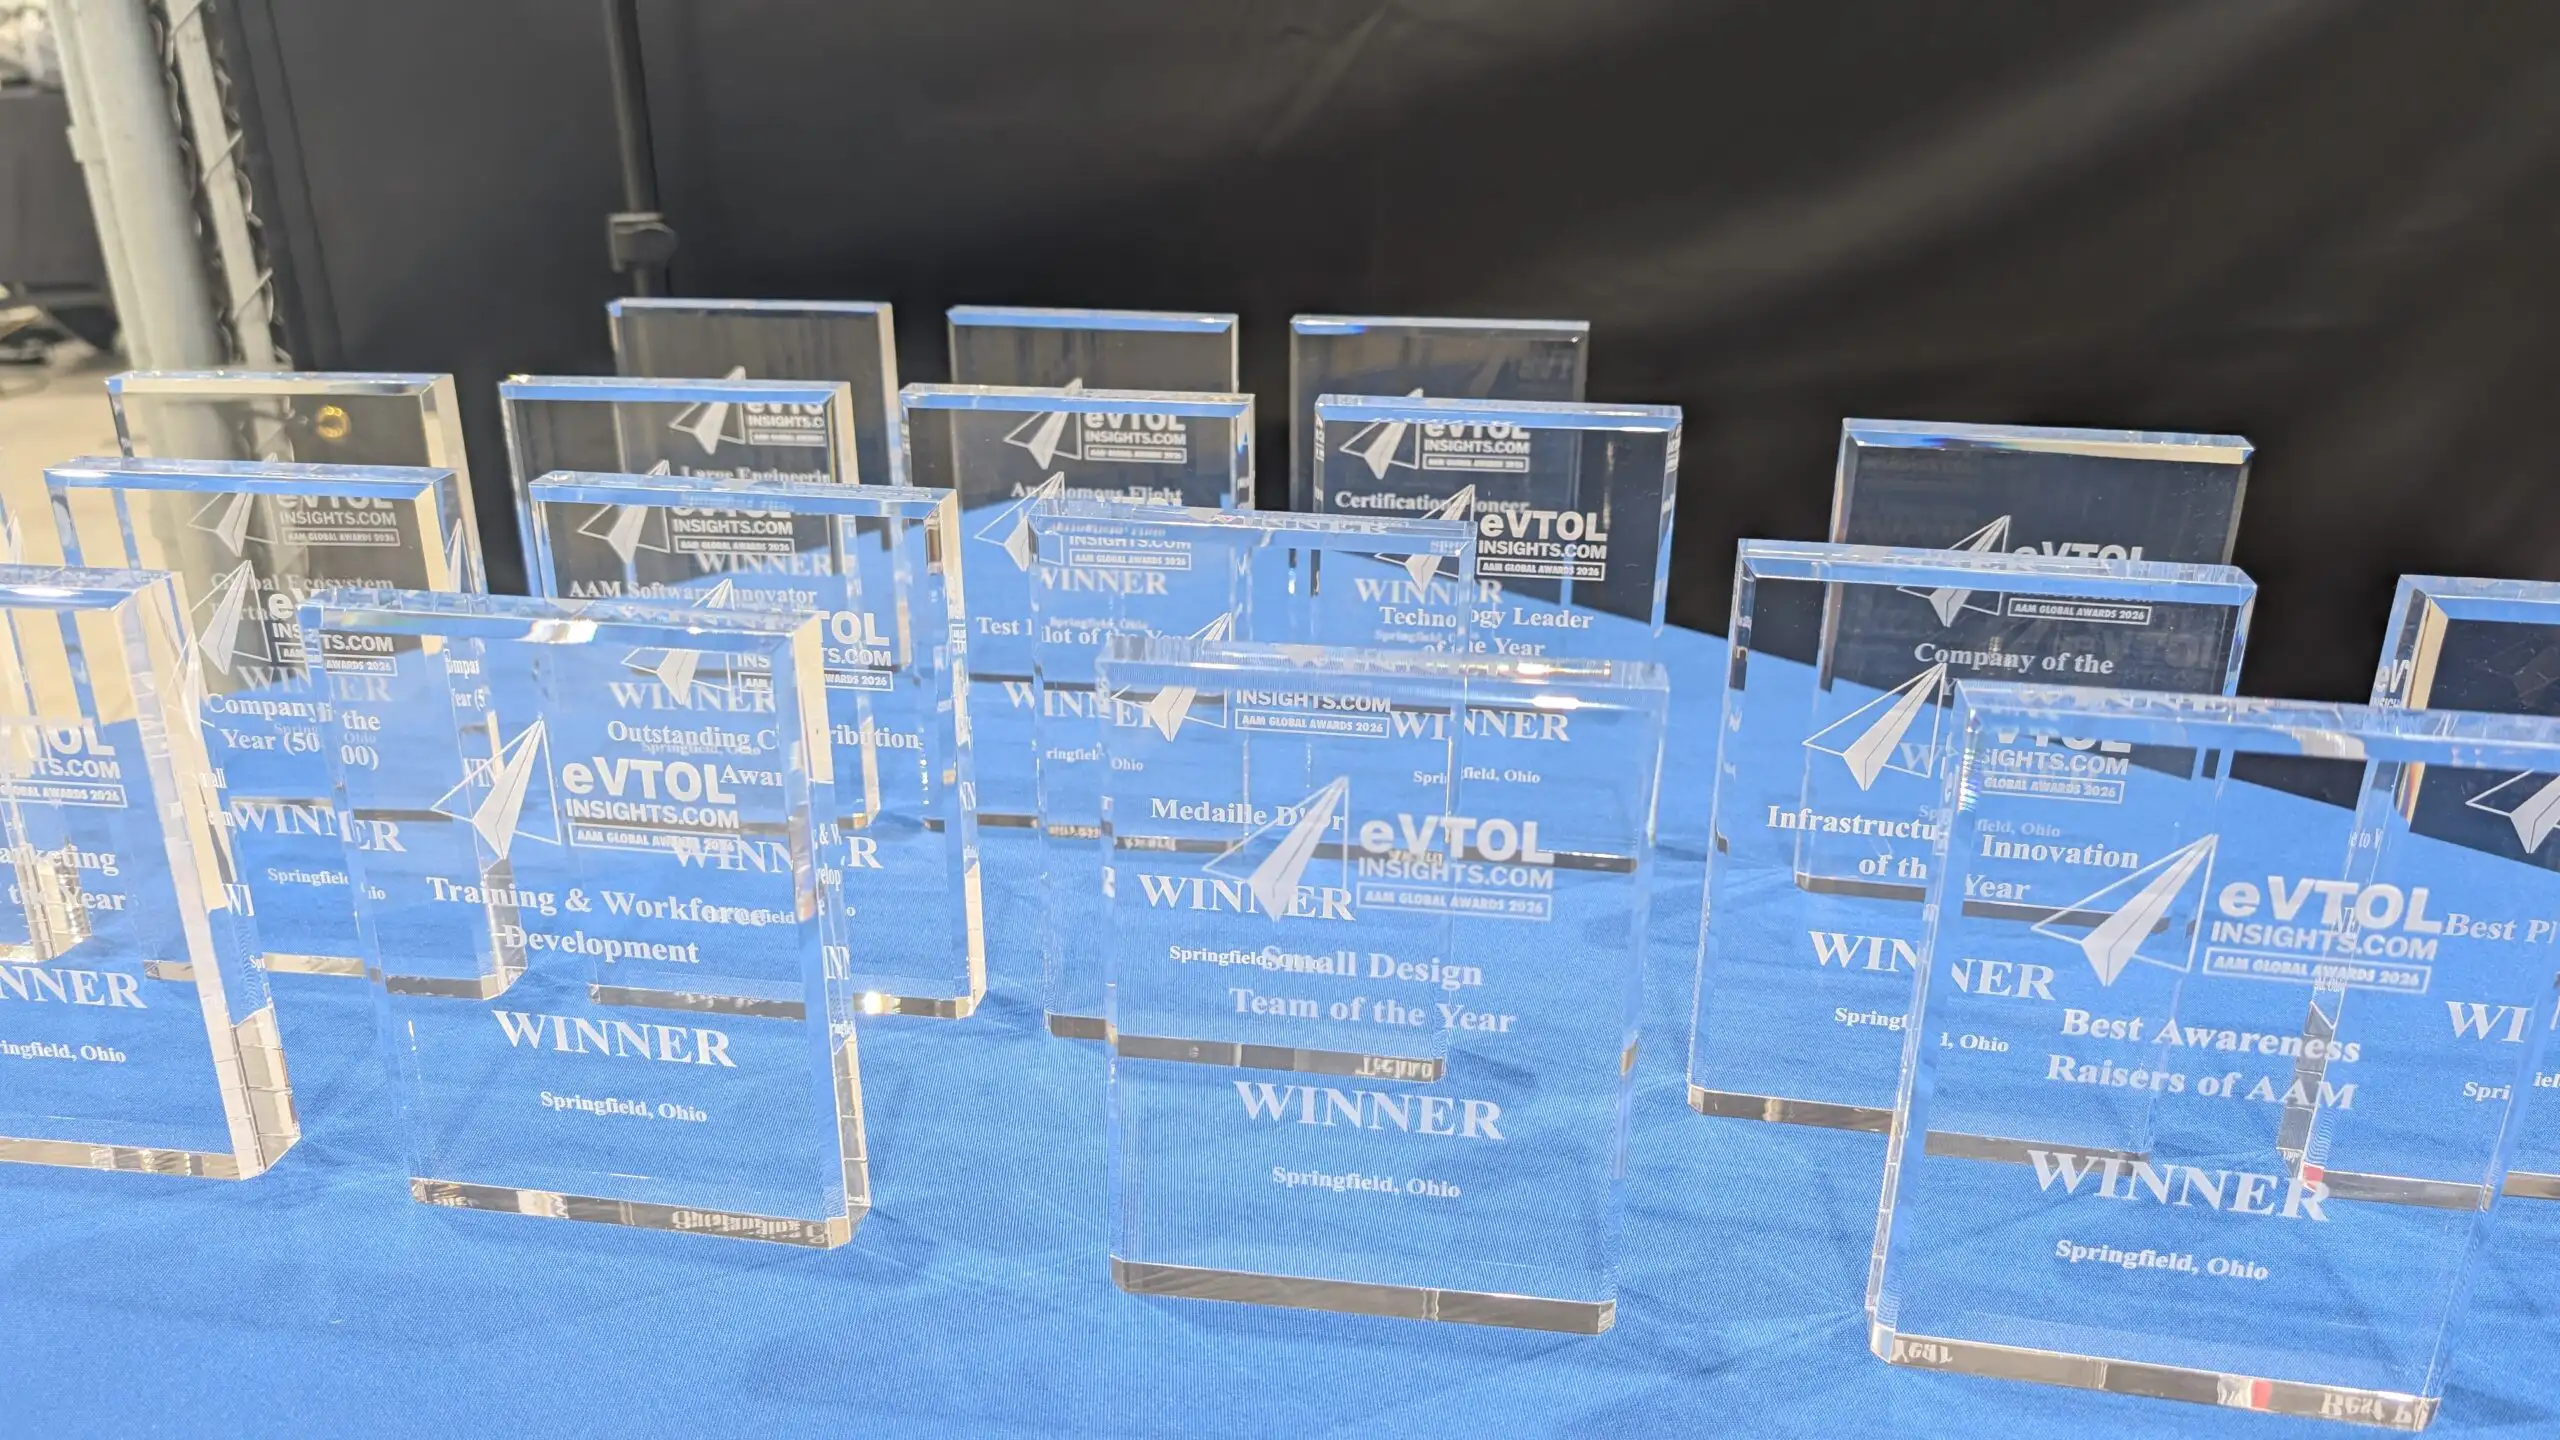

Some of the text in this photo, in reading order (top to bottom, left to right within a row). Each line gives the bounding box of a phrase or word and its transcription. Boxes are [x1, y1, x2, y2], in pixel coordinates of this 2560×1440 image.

[747, 415, 825, 429] INSIGHTS.C
[1084, 430, 1187, 445] INSIGHTS.COM
[1424, 439, 1531, 454] INSIGHTS.COM
[737, 467, 830, 483] Engineerin
[279, 511, 398, 526] INSIGHTS.COM
[673, 518, 794, 536] INSIGHTS.COM
[1480, 510, 1608, 542] eVTOL
[1478, 540, 1607, 559] INSIGHTS.COM
[696, 553, 834, 577] WINNER
[1504, 563, 1537, 574] GLOBAL
[1537, 565, 1576, 576] AWARDS
[1576, 566, 1601, 577] 2026
[569, 580, 622, 598] AAM
[627, 582, 714, 602] Softwar
[1354, 578, 1504, 606] WINNR
[1379, 606, 1595, 630] Technoogy Leader
[2013, 603, 2146, 620] AAM GLOBAL AWARDS 2026
[975, 616, 1020, 636] Test
[1078, 628, 1101, 645] of
[1494, 638, 1547, 657] Year
[1913, 642, 2115, 675] Company of the
[326, 660, 364, 671] AWARDS
[366, 660, 392, 672] 2026
[824, 673, 860, 686] WARDS
[861, 675, 888, 687] 2026
[236, 665, 393, 702] WINER
[208, 692, 318, 722] Company
[342, 710, 381, 731] the
[1236, 688, 1392, 713] INSIGHTS.COM
[607, 719, 751, 752] Outstanding
[1242, 714, 1384, 733] AAM GLOBAL AWARDS 2026
[220, 728, 277, 751] Year
[1111, 757, 1144, 772] Ohio
[1413, 766, 1541, 786] Sprifield, Ohio
[562, 756, 736, 805] eVTOL
[1983, 777, 2116, 798] GLOBAL AWARDS 2026
[90, 789, 120, 802] 2026
[565, 798, 740, 829] INSIGHTS.COM
[1150, 797, 1345, 832] Medaille D'r
[577, 830, 604, 842] AAM
[606, 831, 650, 846] GLOBAL
[1359, 813, 1556, 864] eVTOL
[1766, 805, 2140, 869] Infrastructu Innovation
[2020, 822, 2062, 838] Ohio
[670, 835, 883, 873] WINNR
[267, 867, 350, 887] Springfiel
[1358, 857, 1555, 890] INSIGHTS.COM
[1858, 855, 2032, 902] of th Year
[60, 885, 126, 911] Year
[426, 876, 557, 917] Training
[565, 886, 592, 913] &
[602, 889, 770, 928] Workforce
[1364, 890, 1545, 915] AAM GLOBAL AWARDS 2026
[2218, 875, 2444, 935] eVTOL
[2210, 920, 2438, 961] INSIGHTS.COM
[2443, 912, 2518, 941] Best
[501, 923, 700, 965] Development
[1261, 944, 1483, 991] Small Design
[2212, 956, 2421, 987] AAM GLOBAL AWARDS 2026
[0, 964, 148, 1009] NNER
[1229, 986, 1518, 1034] Team of the Year
[493, 1009, 738, 1068] WINNER
[1959, 1033, 2010, 1053] Ohio
[2061, 1007, 2361, 1063] Best Awareness
[0, 1040, 127, 1063] ingfield, Ohio
[2047, 1054, 2359, 1111] Raisers of AAM
[540, 1091, 708, 1123] Springfield, Ohio
[1234, 1080, 1505, 1140] WINNER
[1272, 1165, 1462, 1198] Springfield, Ohio
[2027, 1149, 2331, 1222] WINNER
[2055, 1239, 2269, 1281] Springfield, Ohio
